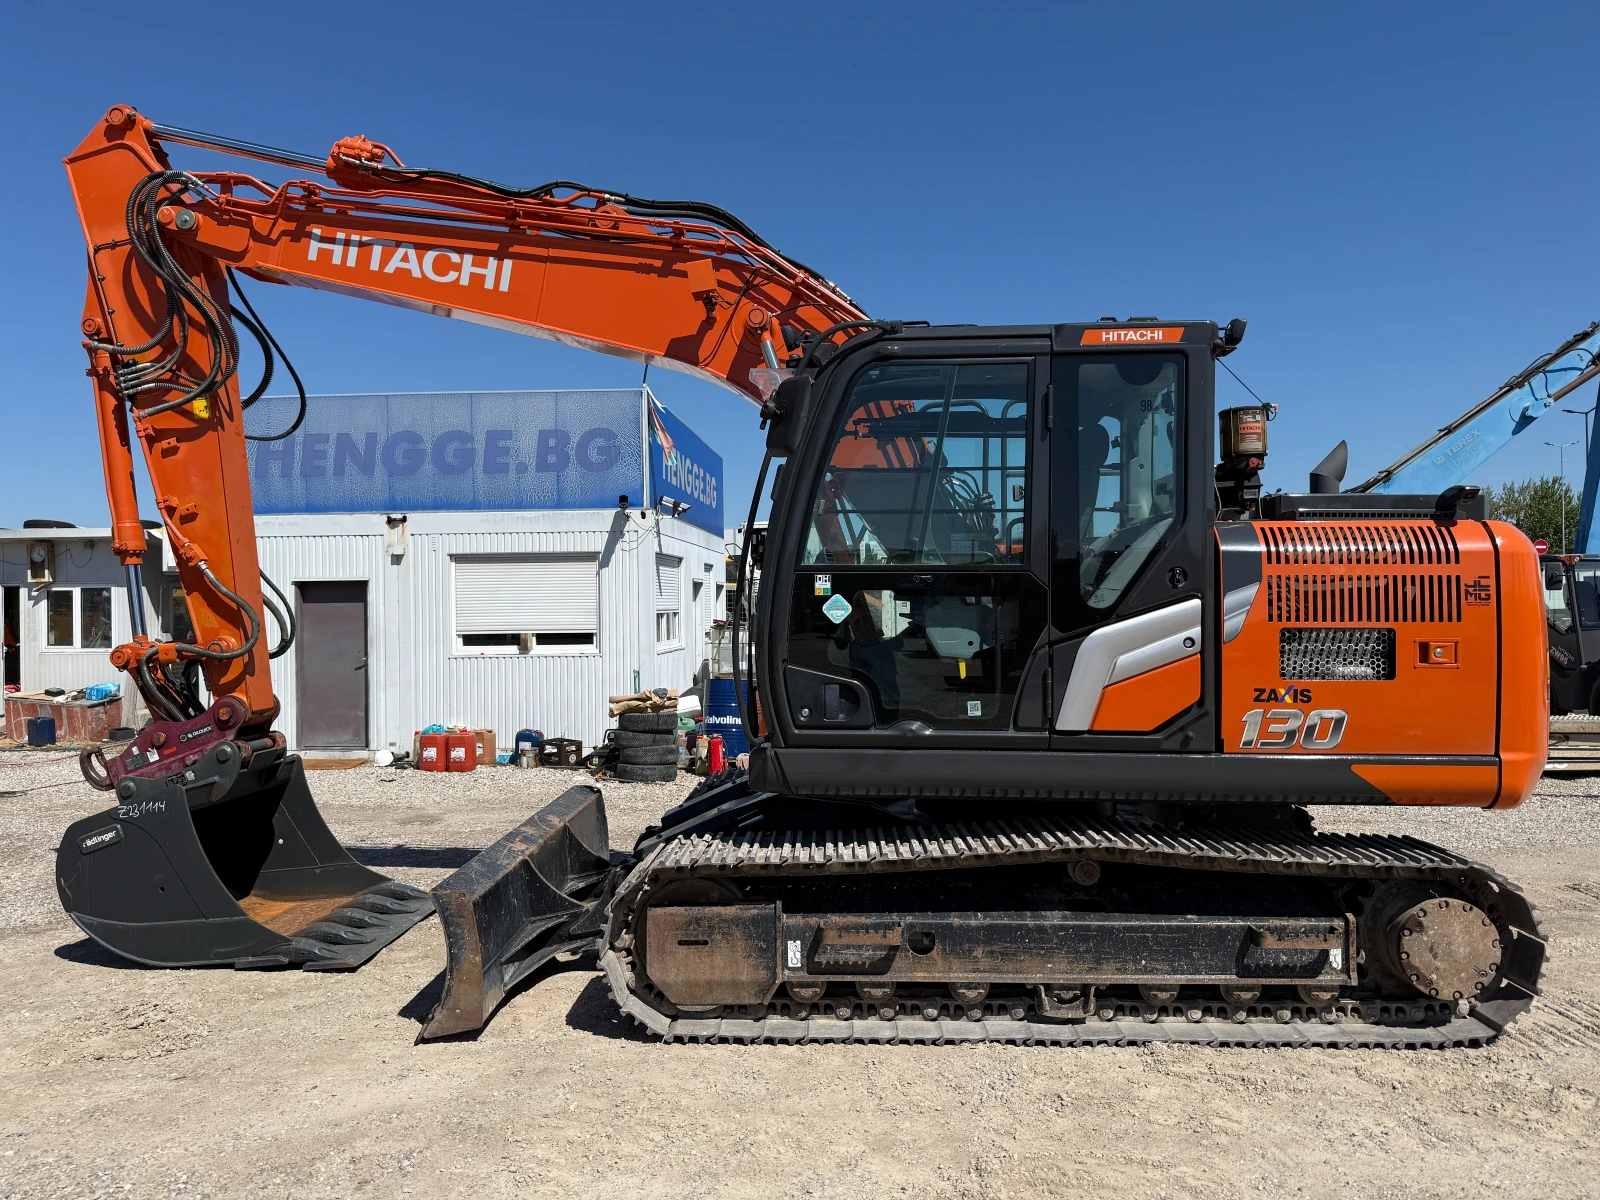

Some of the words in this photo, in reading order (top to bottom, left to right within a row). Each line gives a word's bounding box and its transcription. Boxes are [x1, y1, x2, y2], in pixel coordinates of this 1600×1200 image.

[307, 228, 513, 292] HITACHI
[1102, 330, 1163, 341] HITACHI
[1140, 399, 1152, 412] 98
[254, 427, 620, 477] HENGGE.BG
[1445, 428, 1481, 456] TEREX
[1447, 444, 1480, 470] FUCHS
[662, 446, 717, 509] HENGGE.BG
[1253, 685, 1312, 703] ZAXIS
[1239, 709, 1348, 749] 130
[118, 800, 166, 818] Z231114
[83, 830, 116, 847] rädlinger
